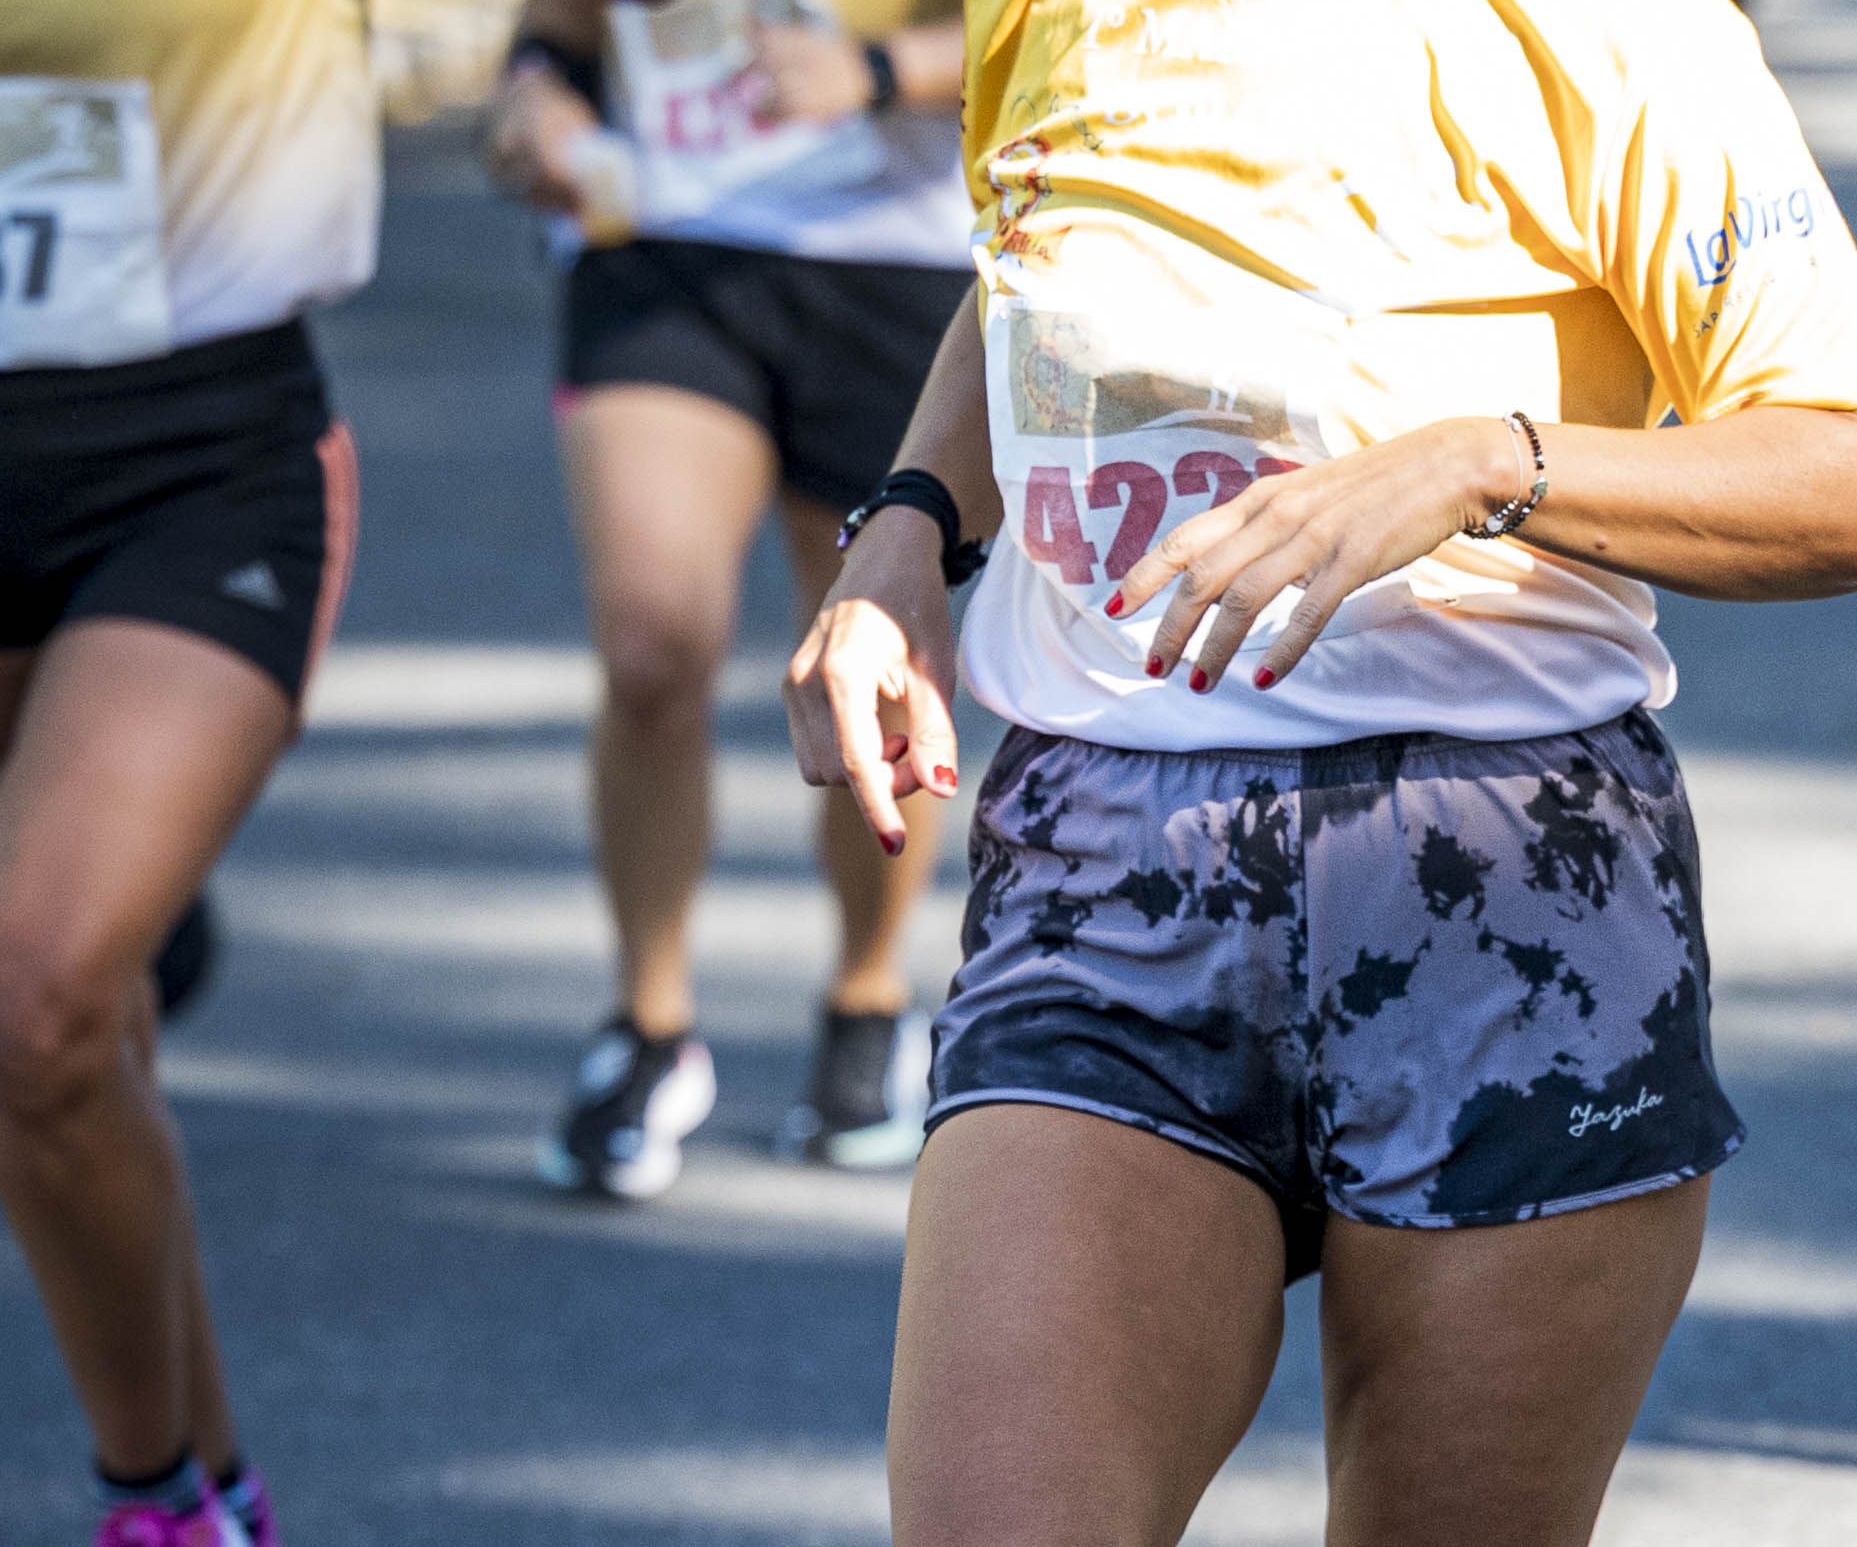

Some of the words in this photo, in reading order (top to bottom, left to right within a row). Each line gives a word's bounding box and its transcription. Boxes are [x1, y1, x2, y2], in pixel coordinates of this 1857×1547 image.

[0, 207, 62, 309] 7
[1686, 188, 1828, 287] LaVirg
[1023, 450, 1304, 585] 422
